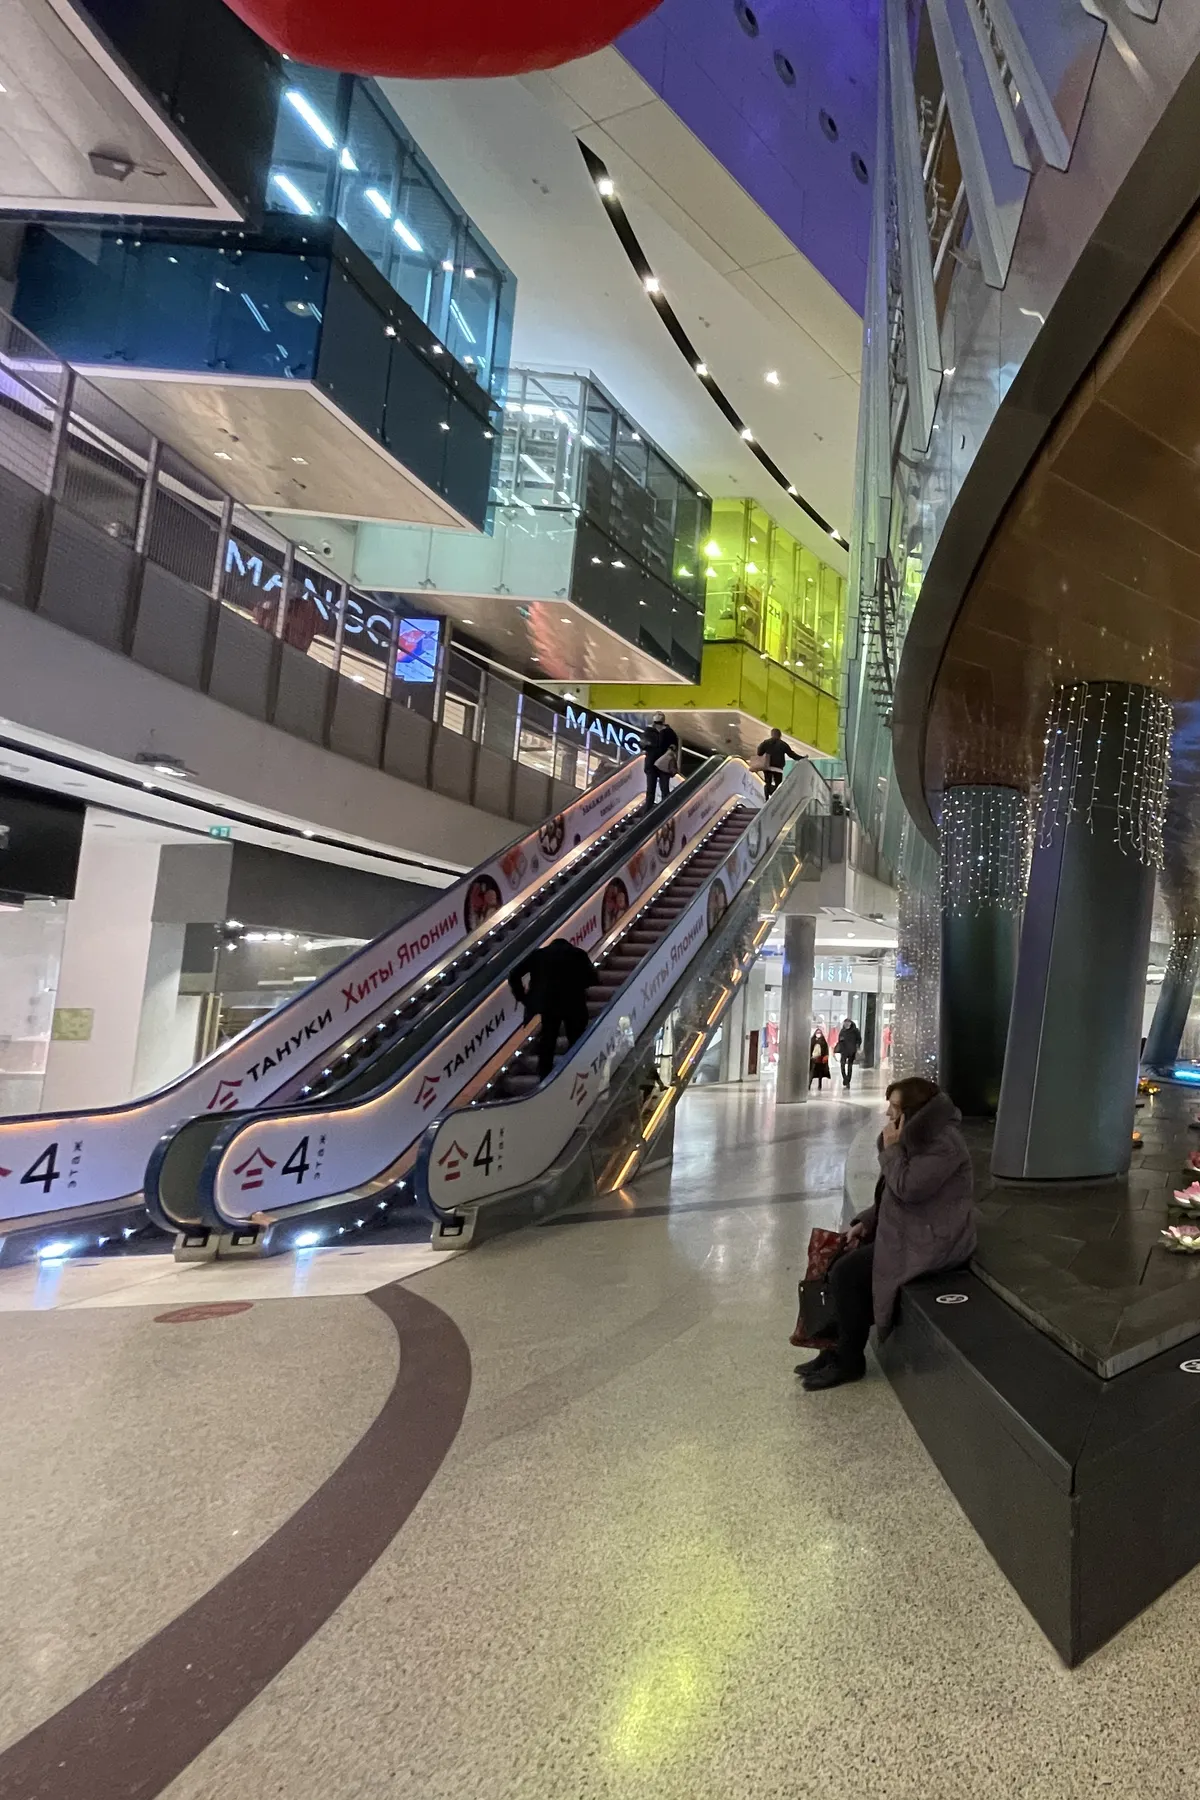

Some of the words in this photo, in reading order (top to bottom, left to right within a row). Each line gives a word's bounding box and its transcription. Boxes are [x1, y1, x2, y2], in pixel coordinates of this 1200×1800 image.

[565, 705, 641, 755] MANG
[640, 962, 670, 1006] Хиты
[670, 914, 704, 969] Японии
[247, 1008, 333, 1082] ТАНУКИ
[341, 960, 394, 1013] Хиты
[397, 911, 459, 969] Японии
[443, 1008, 505, 1078] ТАНУКИ
[569, 915, 597, 947] онии
[20, 1142, 60, 1194] 4
[67, 1140, 83, 1189] этаж
[281, 1135, 310, 1185] 4
[473, 1128, 494, 1177] 4
